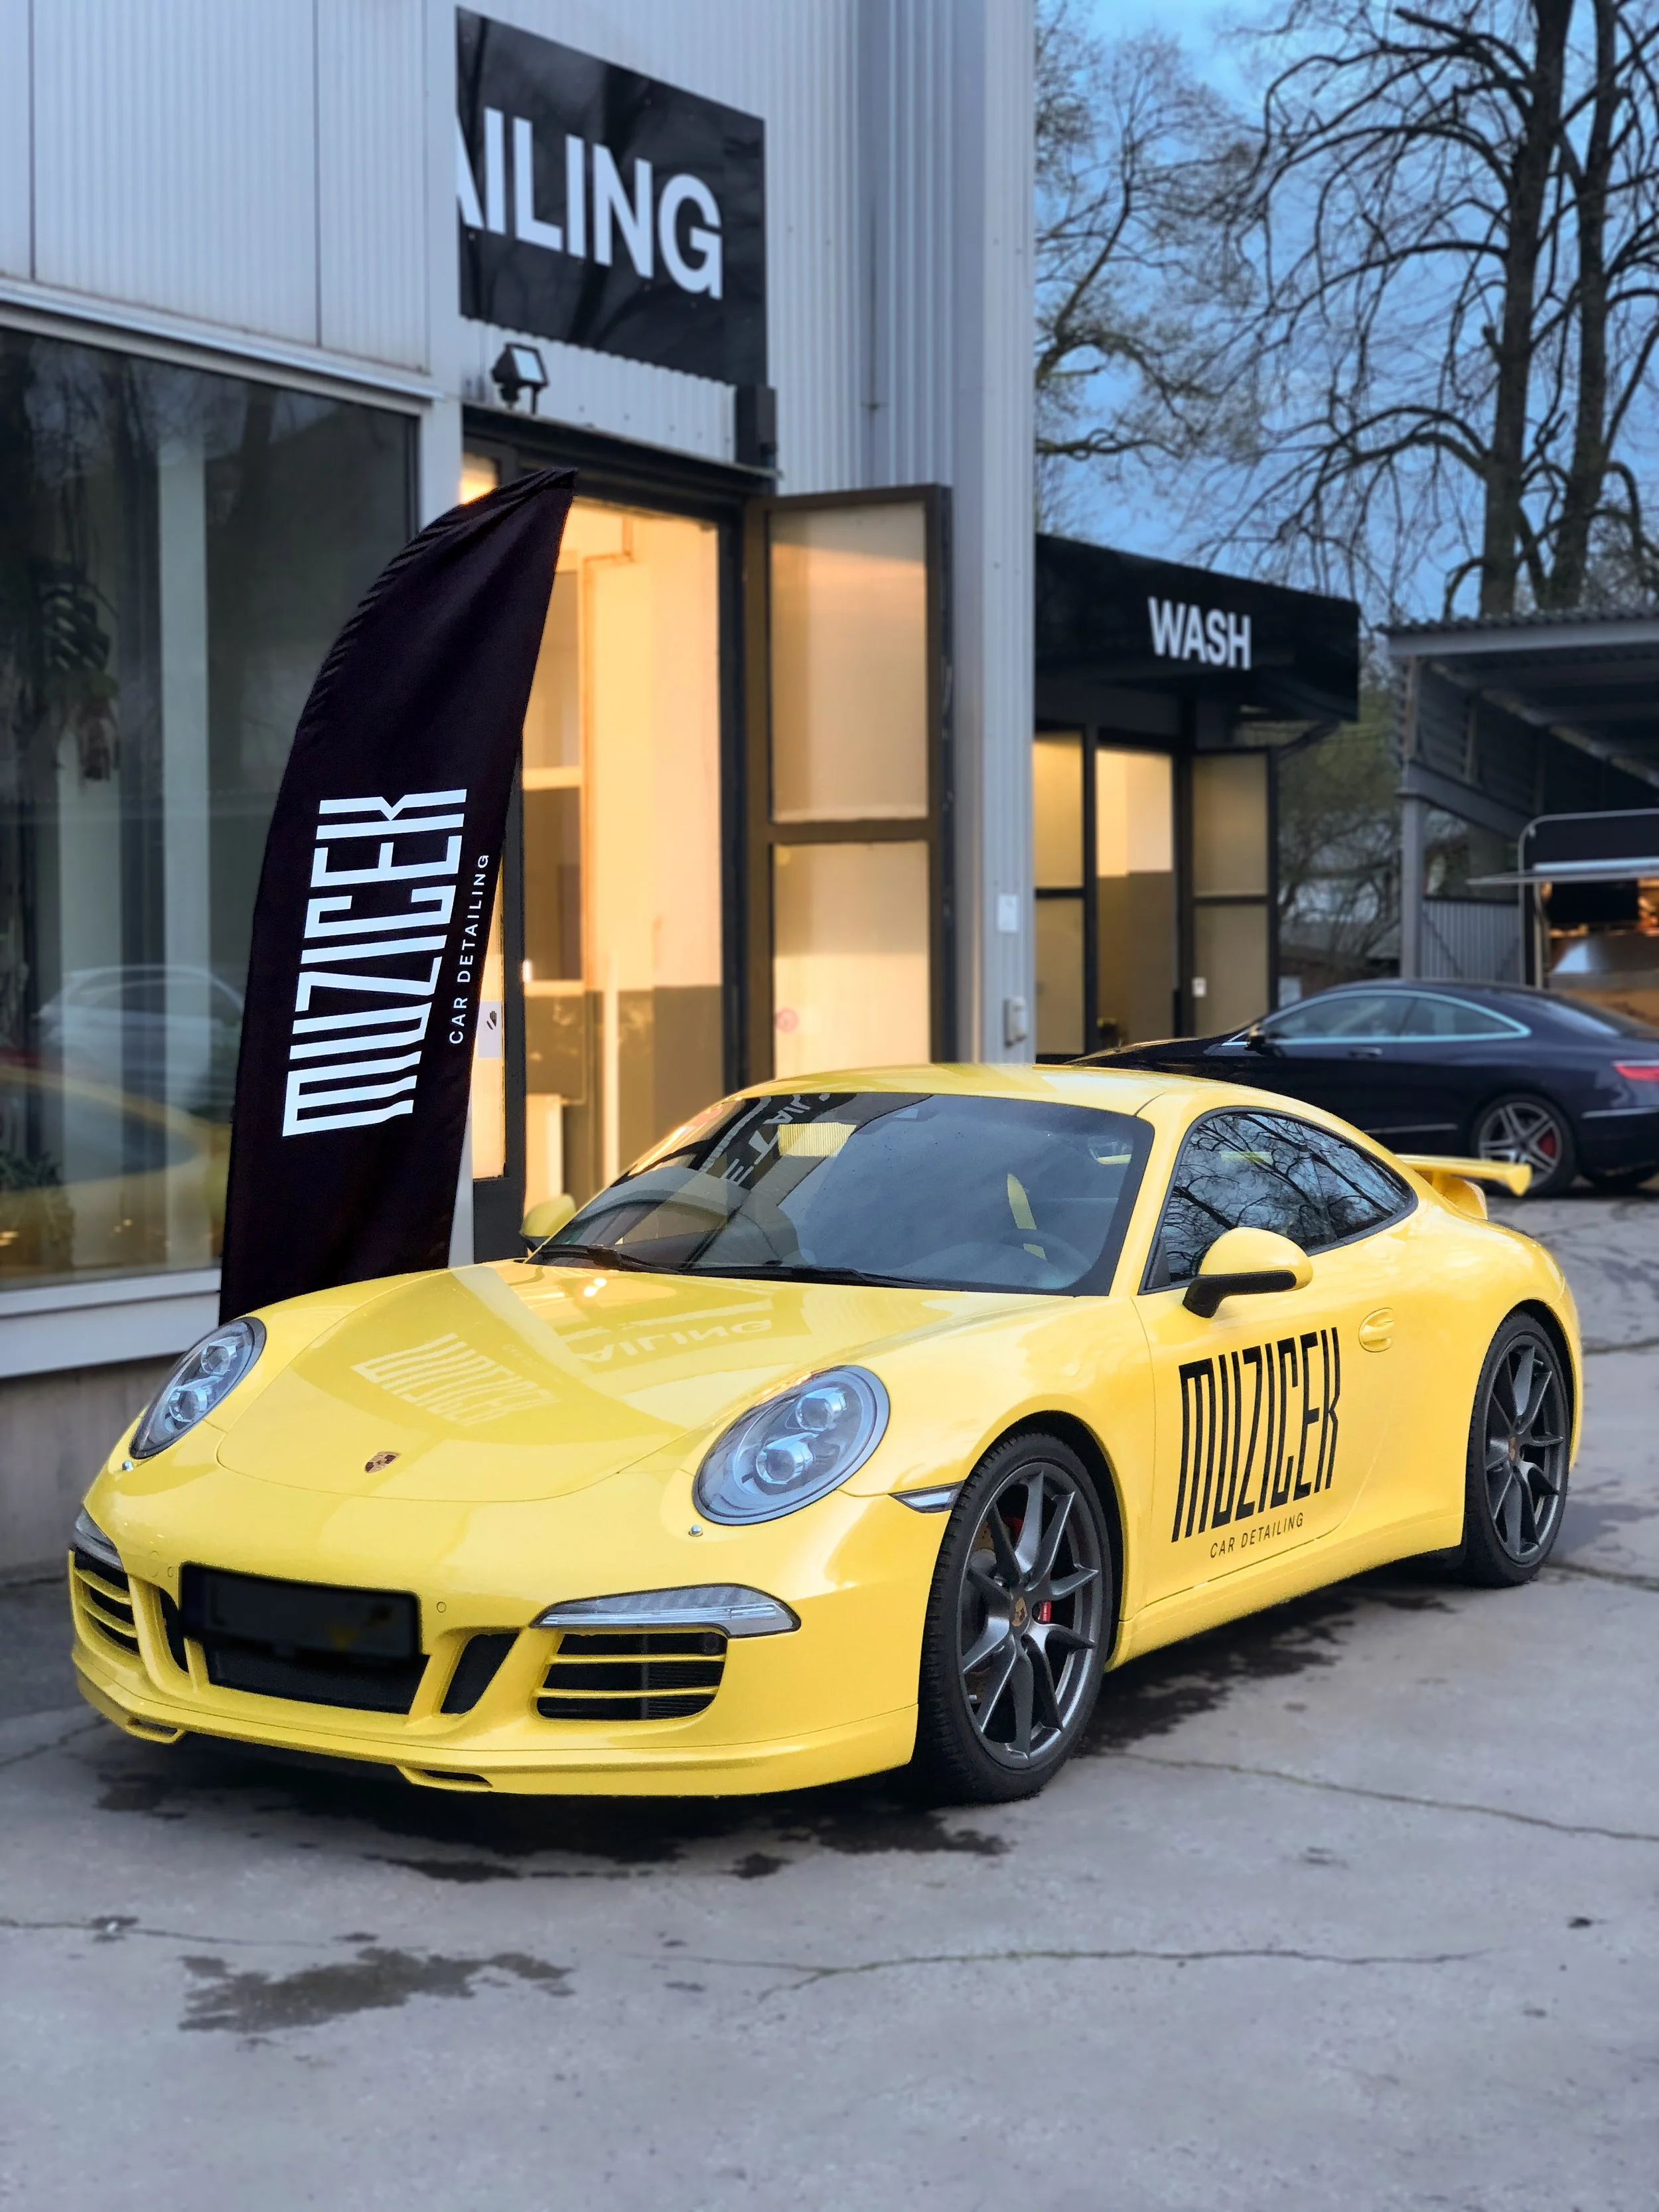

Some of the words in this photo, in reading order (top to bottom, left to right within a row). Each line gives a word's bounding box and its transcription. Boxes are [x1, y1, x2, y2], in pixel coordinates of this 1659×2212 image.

[1149, 598, 1252, 670] WASH
[283, 788, 467, 1136] MUZICEK
[457, 854, 489, 984] DETAILING
[449, 997, 469, 1045] CAR
[1171, 1327, 1340, 1542] MUZICEK
[1210, 1536, 1236, 1558] CAR
[1241, 1512, 1303, 1548] DETAILING
